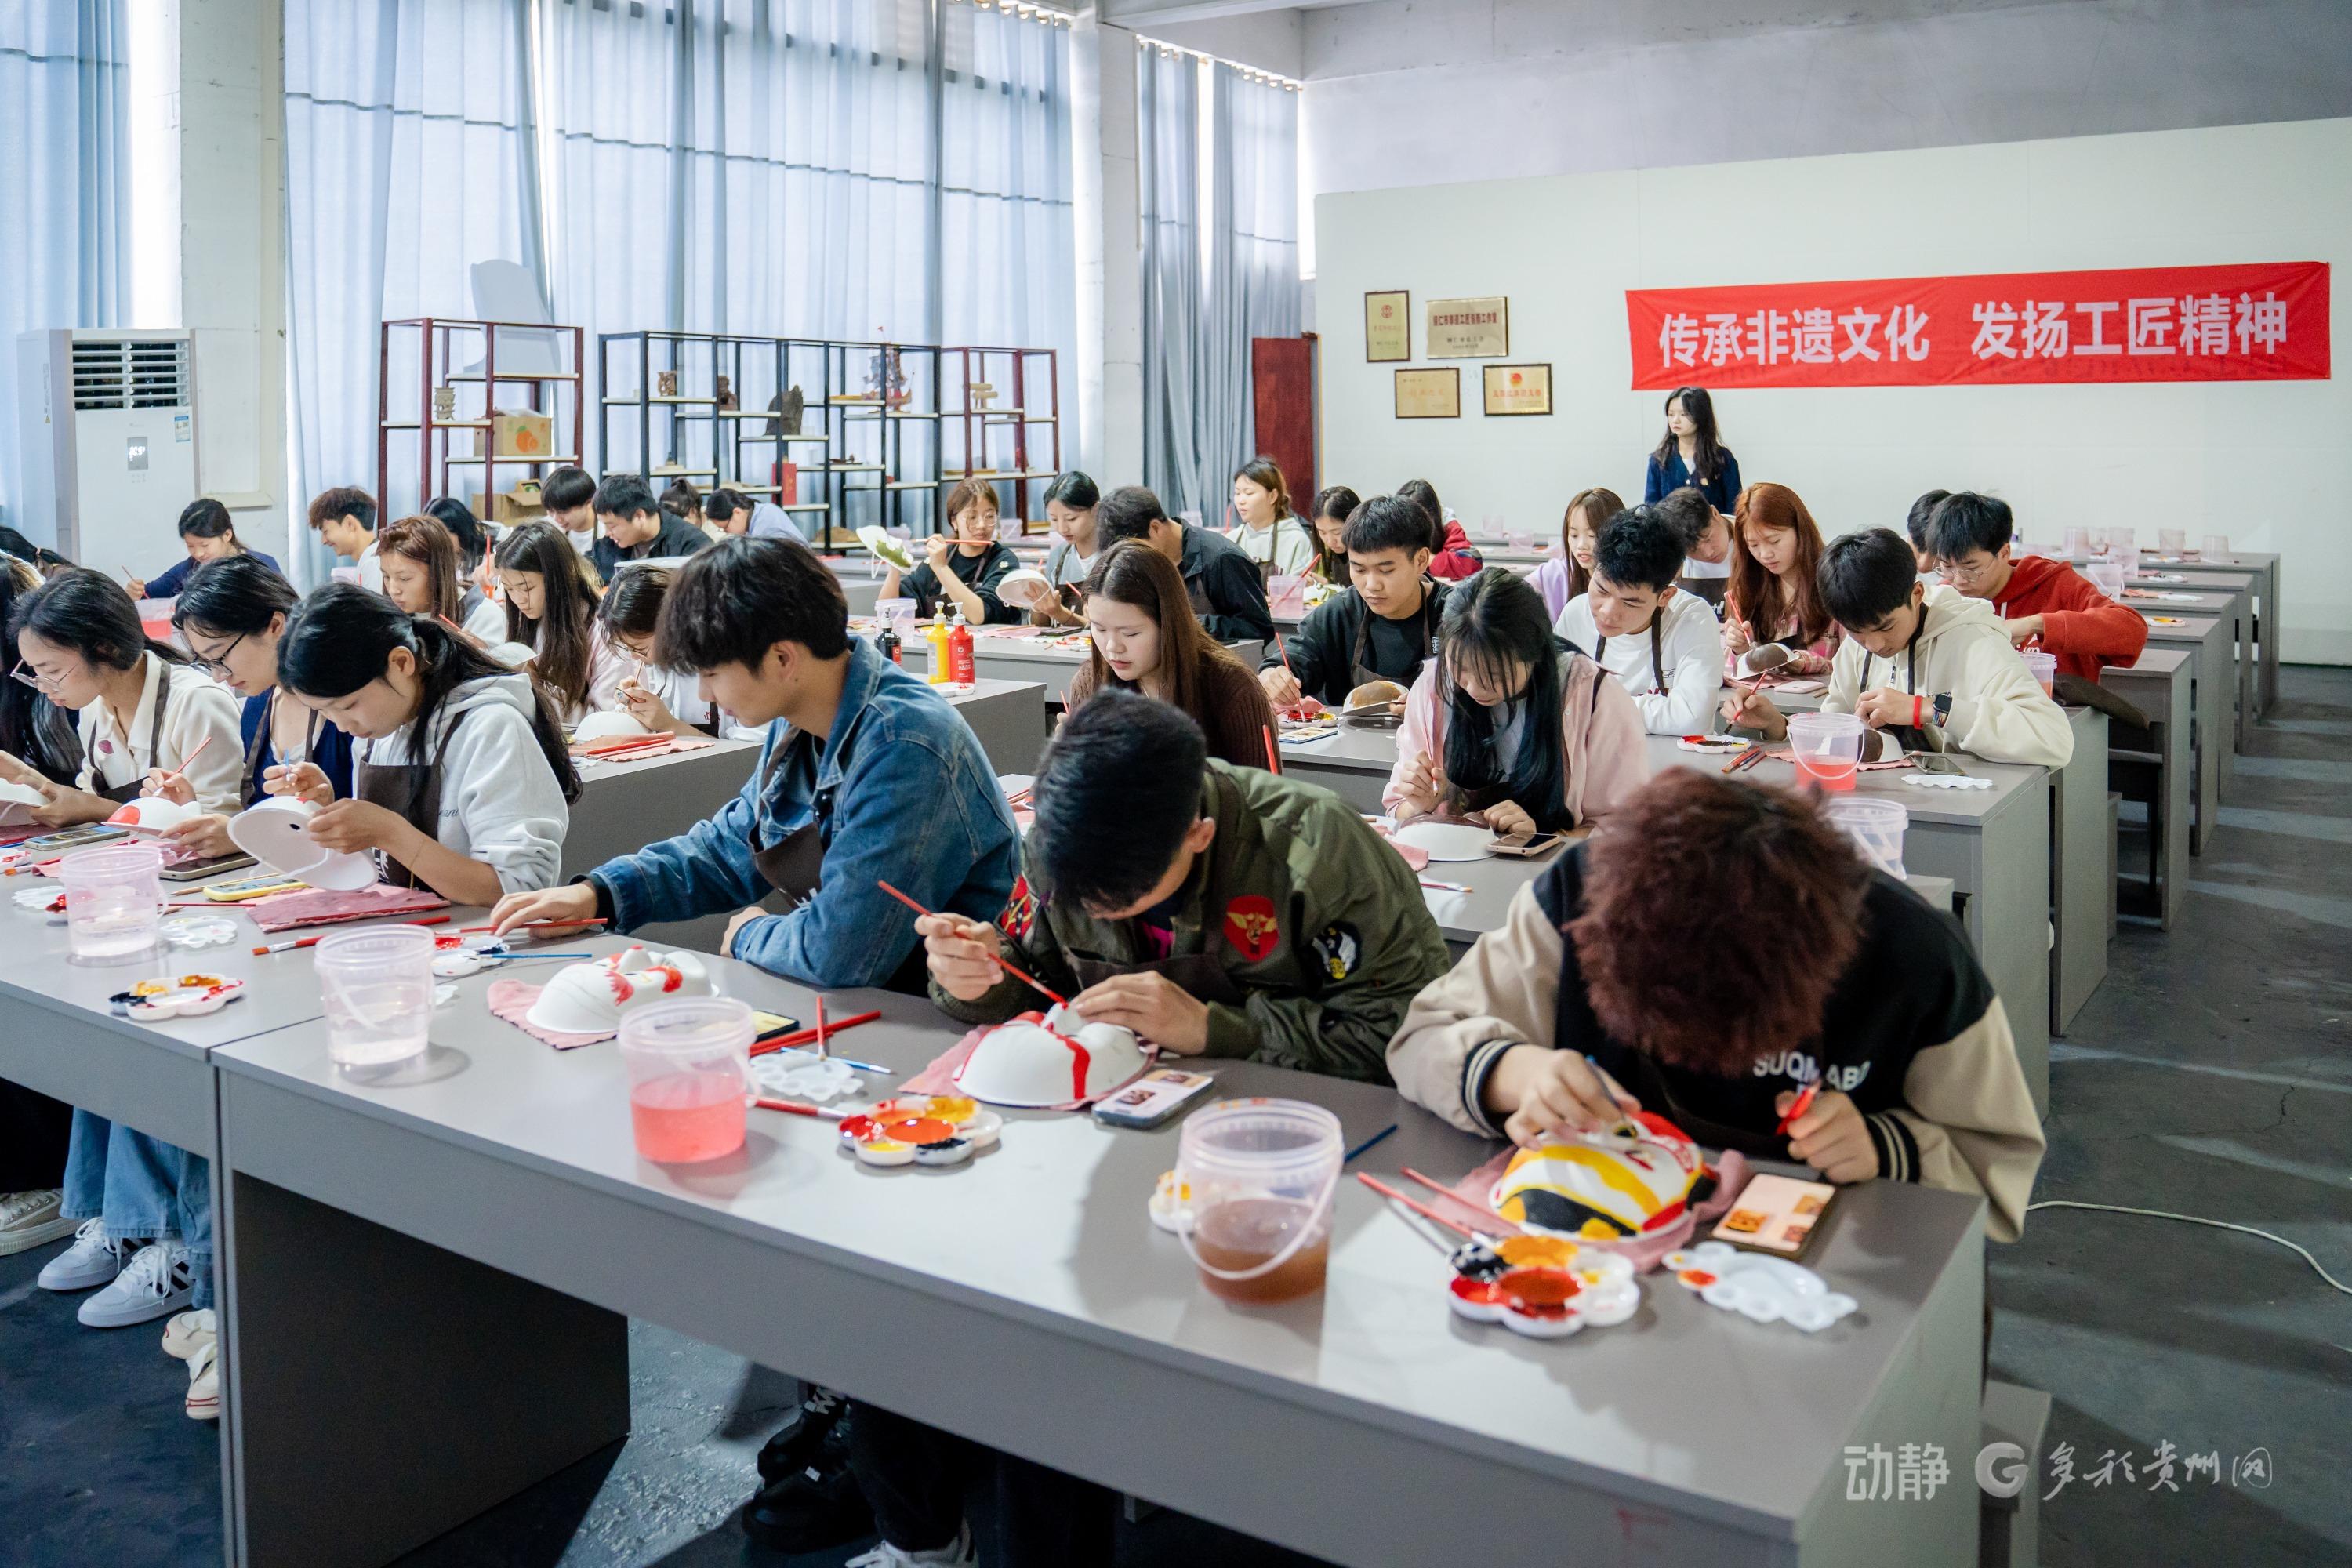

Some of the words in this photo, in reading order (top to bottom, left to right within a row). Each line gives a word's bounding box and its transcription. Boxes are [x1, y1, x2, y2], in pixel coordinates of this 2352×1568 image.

[1658, 303, 1930, 368] 传承非遗文化
[1970, 291, 2288, 360] 发扬工匠精神
